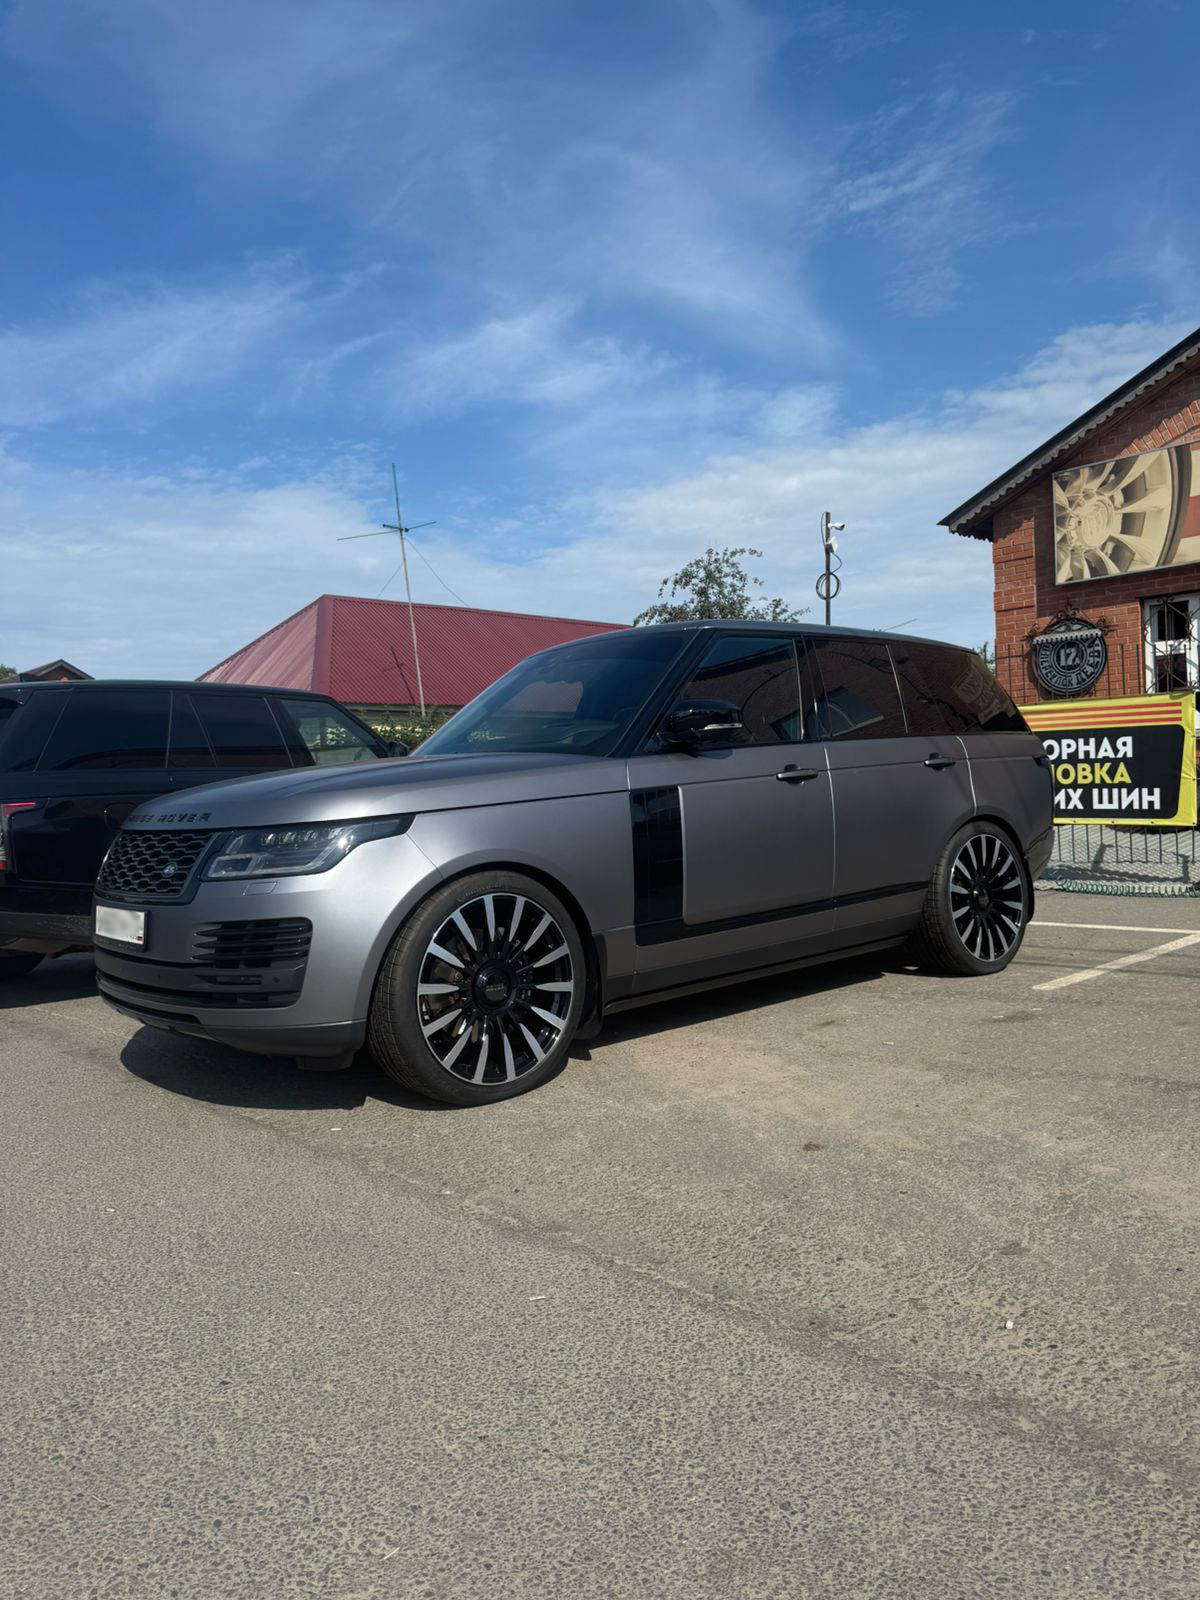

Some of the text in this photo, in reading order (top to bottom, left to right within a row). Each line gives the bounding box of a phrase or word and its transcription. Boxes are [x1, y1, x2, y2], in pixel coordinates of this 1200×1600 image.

[1041, 653, 1074, 687] ПЕРЕУЛОК
[1075, 639, 1100, 686] ДЕЕВА
[1042, 736, 1133, 760] ОРНАЯ
[1051, 762, 1132, 785] ОВКА
[1092, 787, 1161, 810] ШИН
